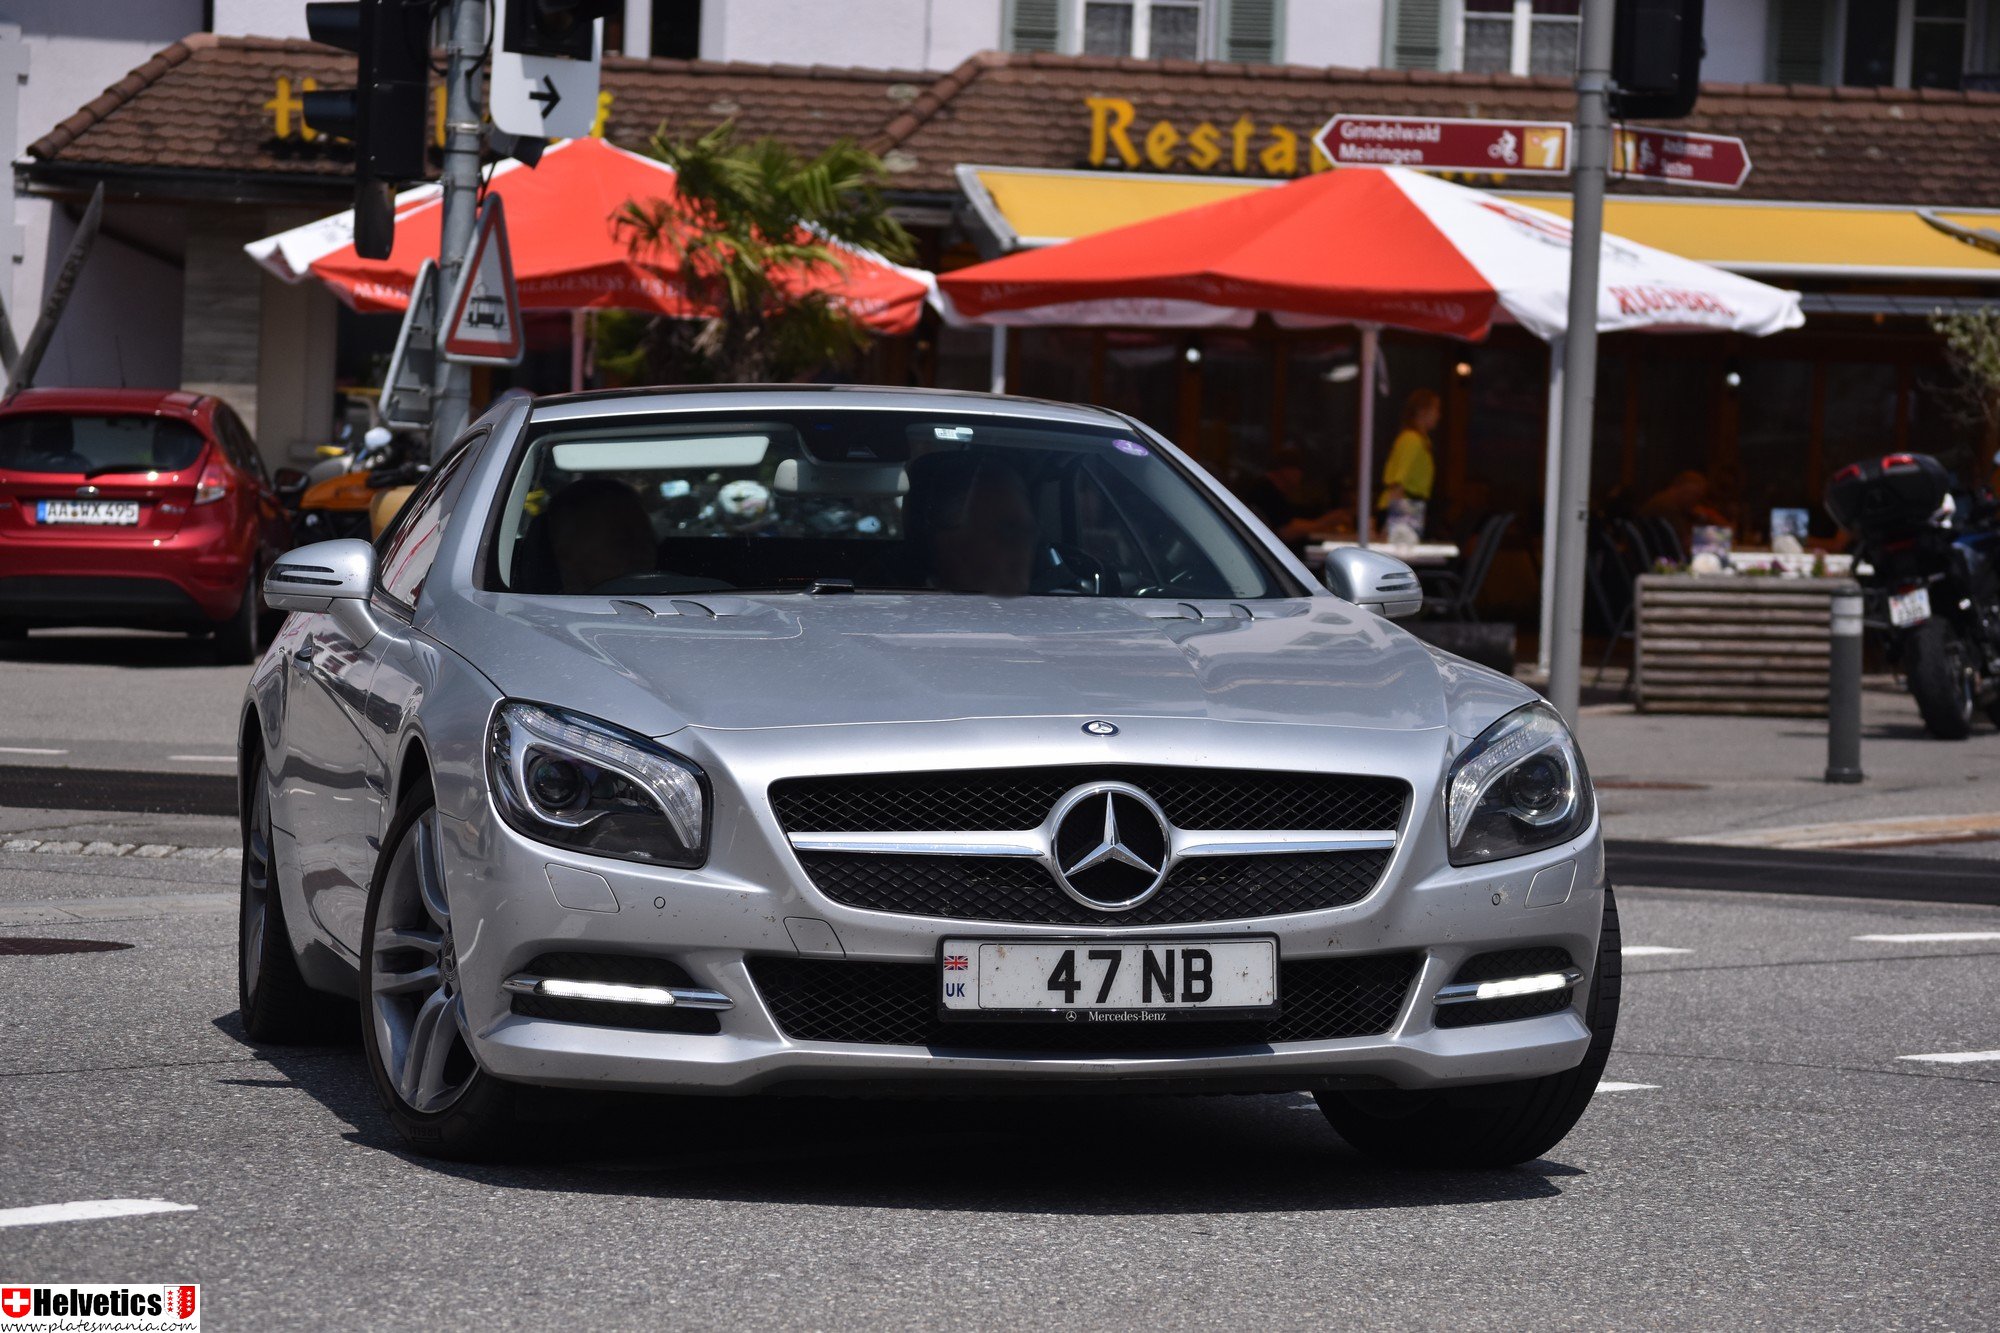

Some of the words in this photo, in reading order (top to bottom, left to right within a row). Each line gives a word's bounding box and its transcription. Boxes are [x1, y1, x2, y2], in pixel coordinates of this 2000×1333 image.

[1340, 121, 1442, 143] Grindelwald
[1338, 143, 1424, 163] Meiringen
[1541, 135, 1560, 167] 1
[47, 502, 69, 517] AA
[80, 503, 101, 518] WX
[105, 503, 136, 519] 495
[1047, 949, 1122, 1004] 47
[1142, 948, 1212, 1004] NB
[946, 982, 966, 998] UK
[1088, 1010, 1167, 1023] Mercedes-Benz
